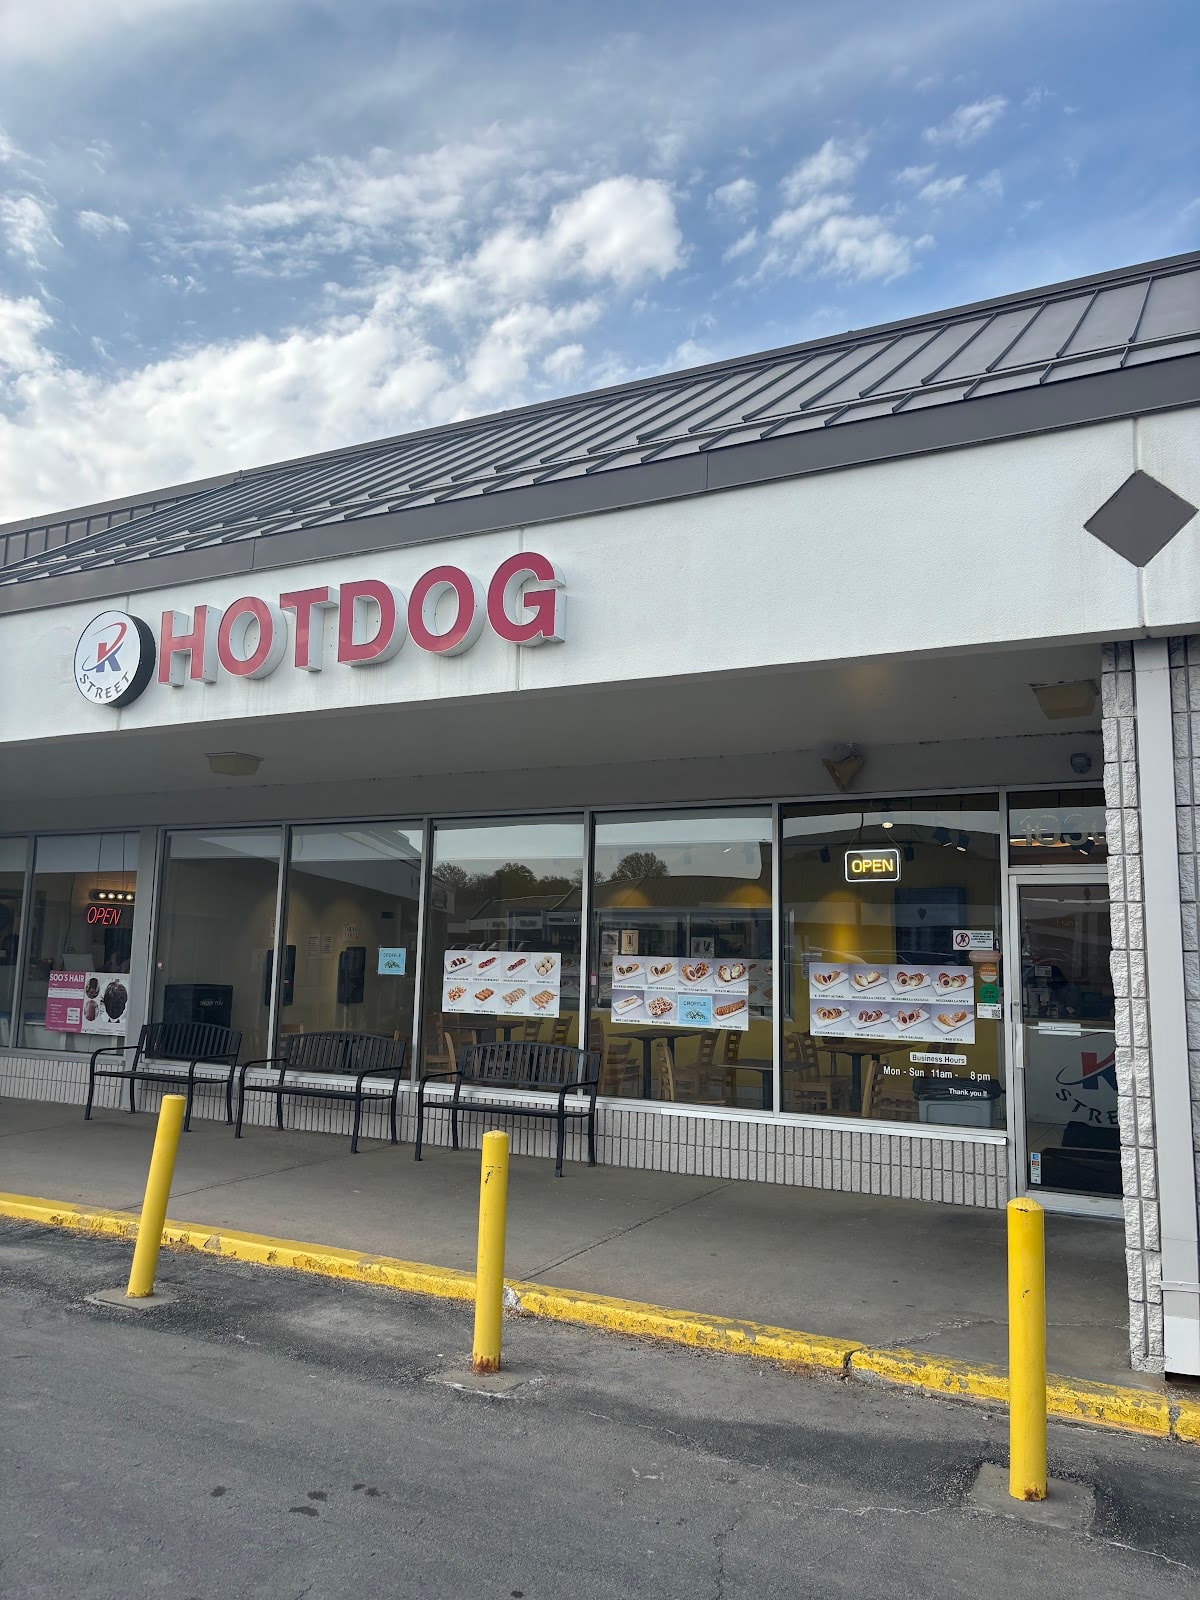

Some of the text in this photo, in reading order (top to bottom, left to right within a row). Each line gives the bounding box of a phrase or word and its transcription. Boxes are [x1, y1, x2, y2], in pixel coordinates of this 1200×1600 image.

[157, 551, 562, 686] HOTDOG
[95, 622, 127, 673] K
[80, 671, 130, 699] STREET
[851, 858, 894, 873] OPEN
[87, 906, 122, 926] OPEN
[49, 973, 85, 983] SOO'S HAIR
[912, 1054, 965, 1064] Business Hours
[883, 1066, 901, 1076] Mon
[909, 1067, 925, 1077] Sun
[930, 1069, 953, 1079] 11am
[970, 1071, 976, 1080] 8
[977, 1073, 991, 1082] pm
[948, 1087, 968, 1096] Thank
